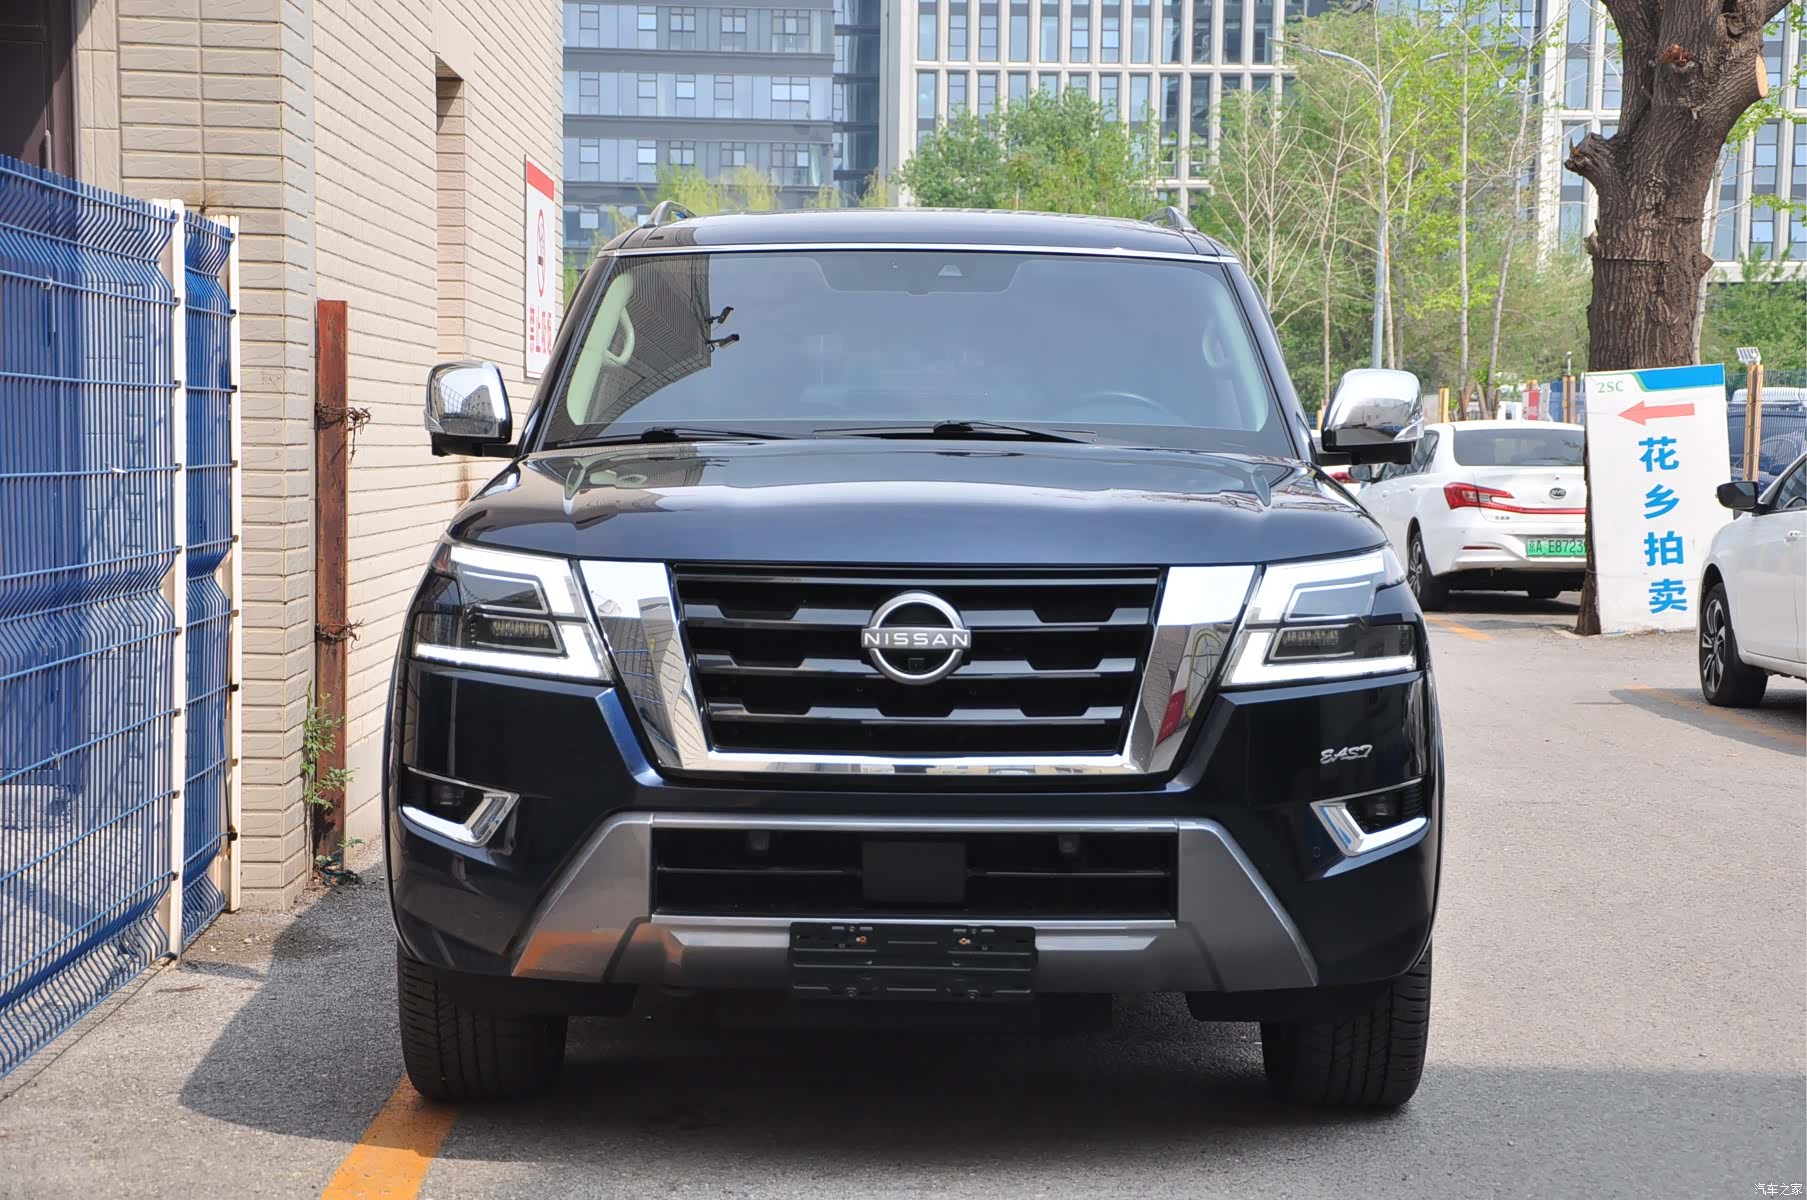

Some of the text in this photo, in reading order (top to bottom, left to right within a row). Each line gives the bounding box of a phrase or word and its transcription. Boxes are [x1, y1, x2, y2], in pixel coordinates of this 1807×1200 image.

[1597, 380, 1624, 393] 2SC
[1638, 436, 1688, 614] 花乡拍卖
[864, 632, 968, 646] NISSAN
[1320, 744, 1373, 764] EAST
